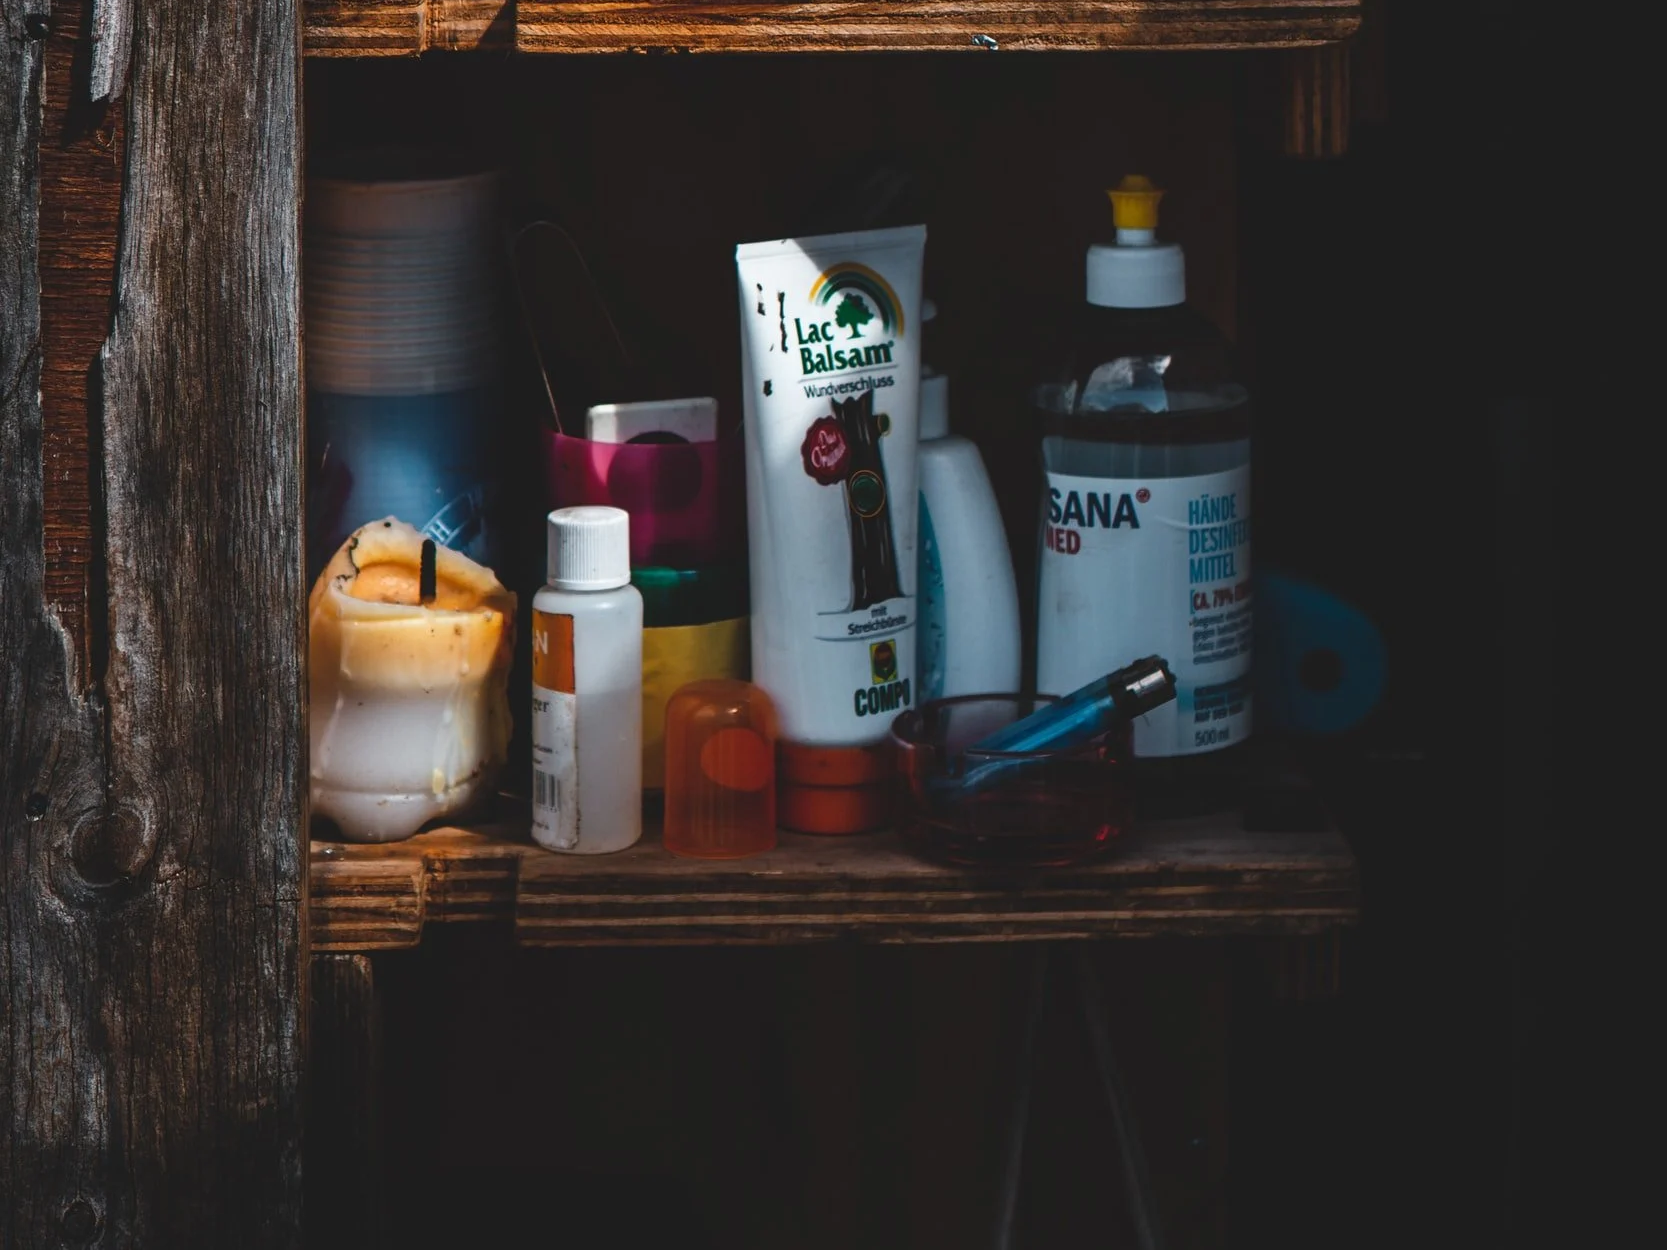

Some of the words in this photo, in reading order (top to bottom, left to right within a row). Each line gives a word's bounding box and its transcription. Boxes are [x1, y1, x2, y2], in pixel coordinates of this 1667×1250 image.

[795, 318, 834, 345] Lac
[803, 375, 895, 399] Wundverschluss
[1188, 494, 1237, 526] HÄNDE
[1189, 552, 1237, 585] MITTEL
[870, 606, 888, 617] mit
